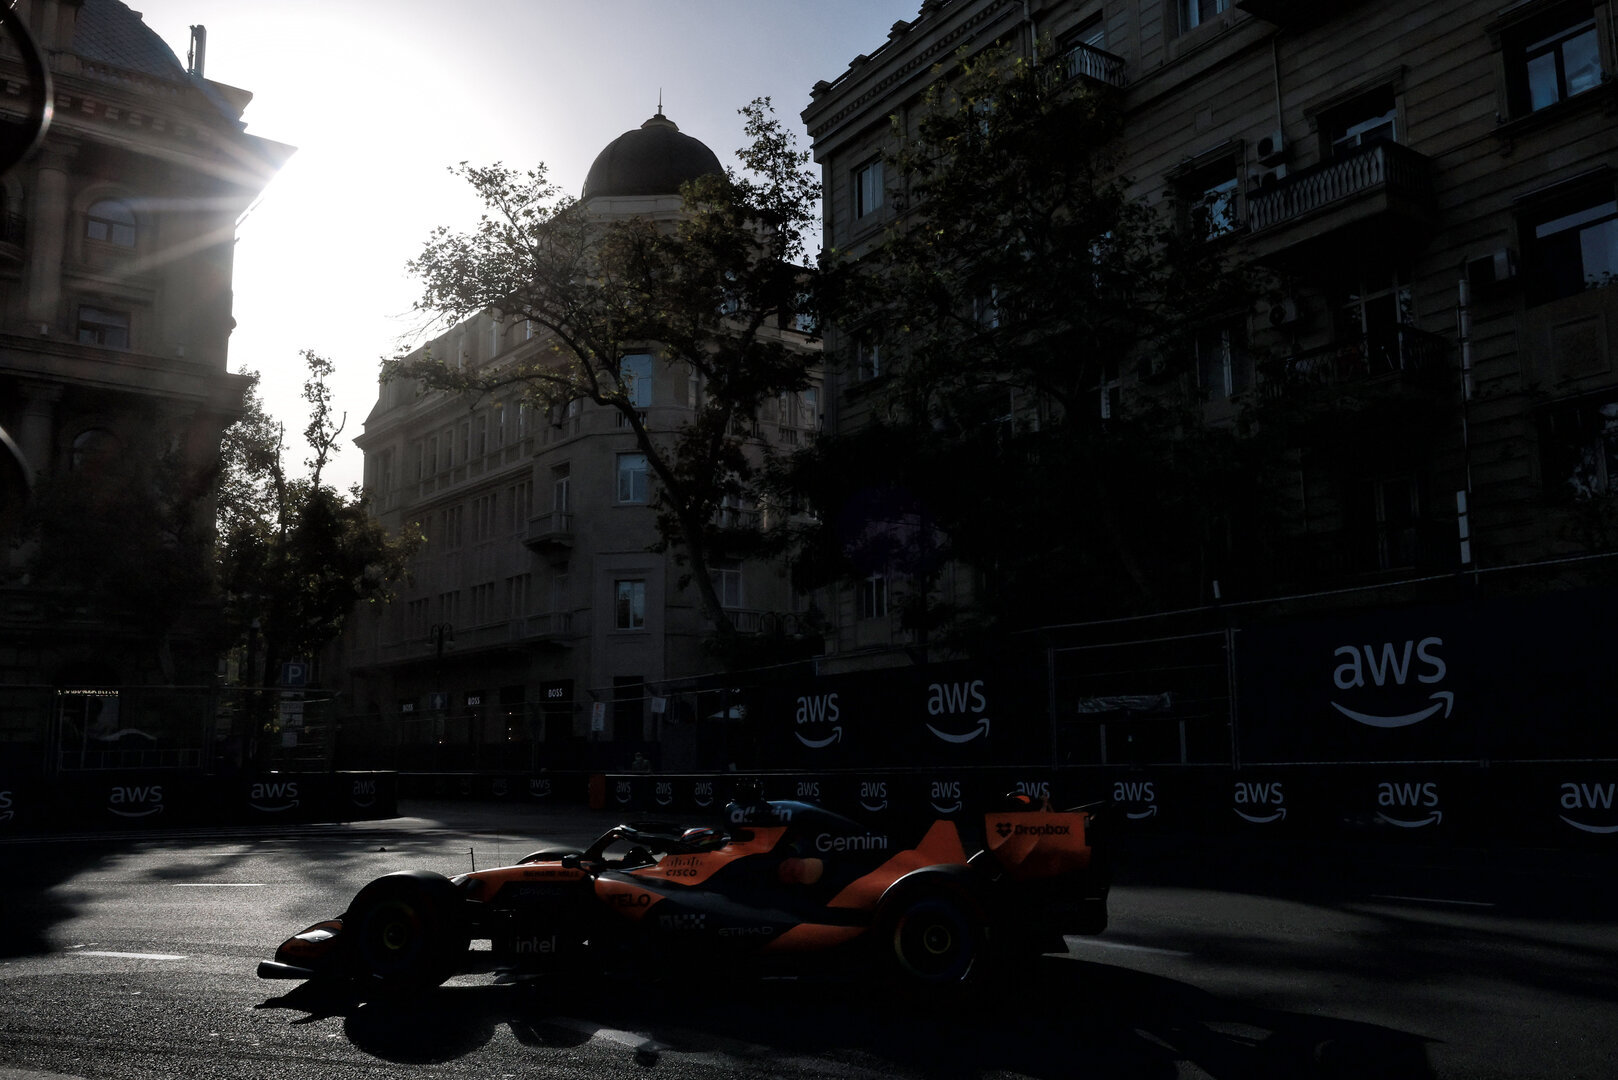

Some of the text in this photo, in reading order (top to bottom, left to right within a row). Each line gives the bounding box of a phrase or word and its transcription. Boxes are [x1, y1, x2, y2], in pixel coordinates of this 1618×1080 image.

[1333, 636, 1447, 690] aws
[288, 665, 302, 684] P
[548, 688, 563, 698] BOSS
[927, 680, 986, 715] aws
[796, 692, 840, 724] aws
[110, 785, 163, 804] aws
[251, 782, 298, 798] aws
[351, 778, 376, 795] aws
[616, 781, 631, 793] aws
[655, 781, 672, 794] aws
[694, 781, 713, 794] aws
[797, 781, 820, 797] aws
[860, 781, 887, 798] aws
[931, 781, 961, 798] aws
[1016, 781, 1050, 799] aws
[1113, 781, 1154, 802] aws
[1234, 782, 1284, 804] aws
[1379, 782, 1439, 807] aws
[1562, 782, 1618, 809] aw
[1014, 824, 1070, 837] Dropbox
[815, 832, 888, 852] Gemini
[718, 926, 774, 936] ETIHAD
[516, 935, 556, 953] intel
